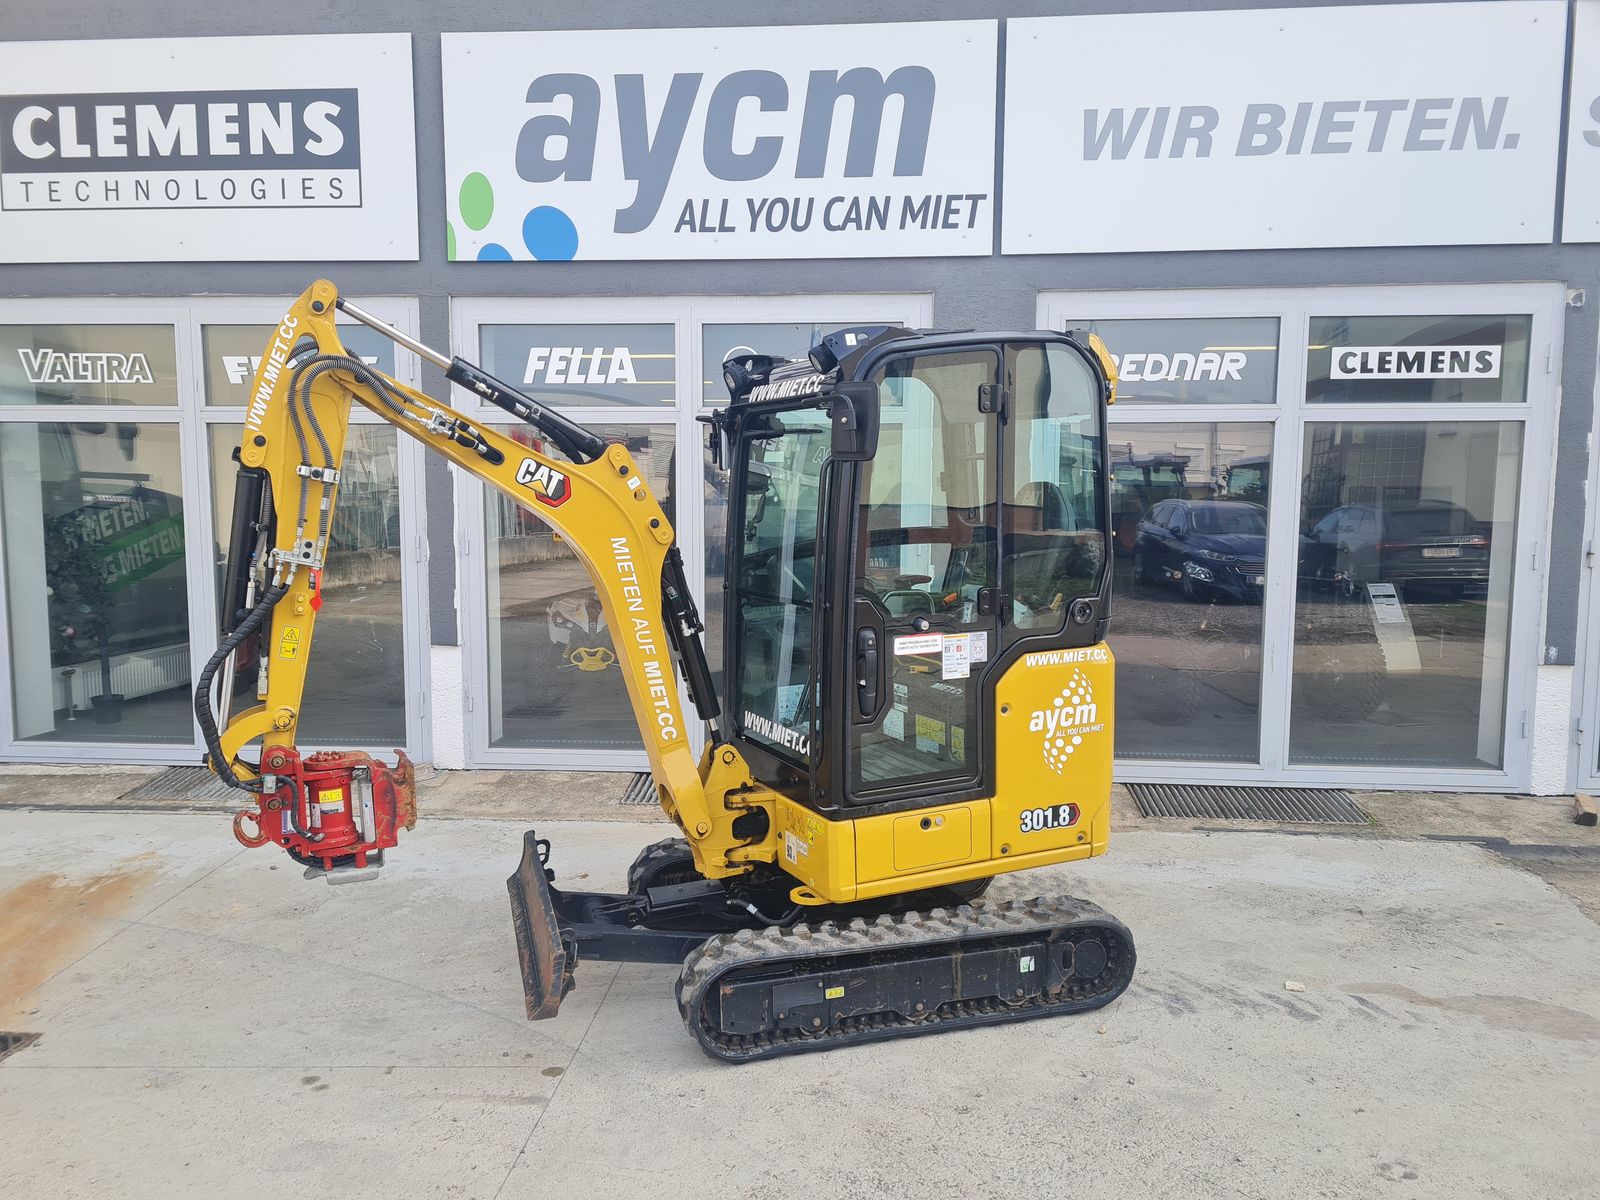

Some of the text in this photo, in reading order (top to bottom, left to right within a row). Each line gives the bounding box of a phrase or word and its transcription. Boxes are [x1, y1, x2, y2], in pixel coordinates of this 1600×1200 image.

[12, 101, 345, 159] CLEMENS
[1082, 105, 1219, 161] WIR
[1234, 96, 1521, 157] BIETEN.
[515, 65, 937, 234] aycm
[20, 178, 344, 203] TECHNOLOGIES
[674, 194, 987, 233] ALL YOU CAN MIET
[17, 349, 154, 384] VALTRA
[523, 347, 638, 384] FELLA
[1338, 350, 1493, 374] CLEMENS
[749, 374, 825, 403] WWW.MIET.CC
[516, 457, 565, 498] CAT
[610, 537, 678, 740] MIETEN AUF MIET.CC
[1029, 703, 1097, 739] aycm
[1056, 723, 1104, 738] ALL YOU CAN MIET
[1020, 804, 1070, 832] 301.8
